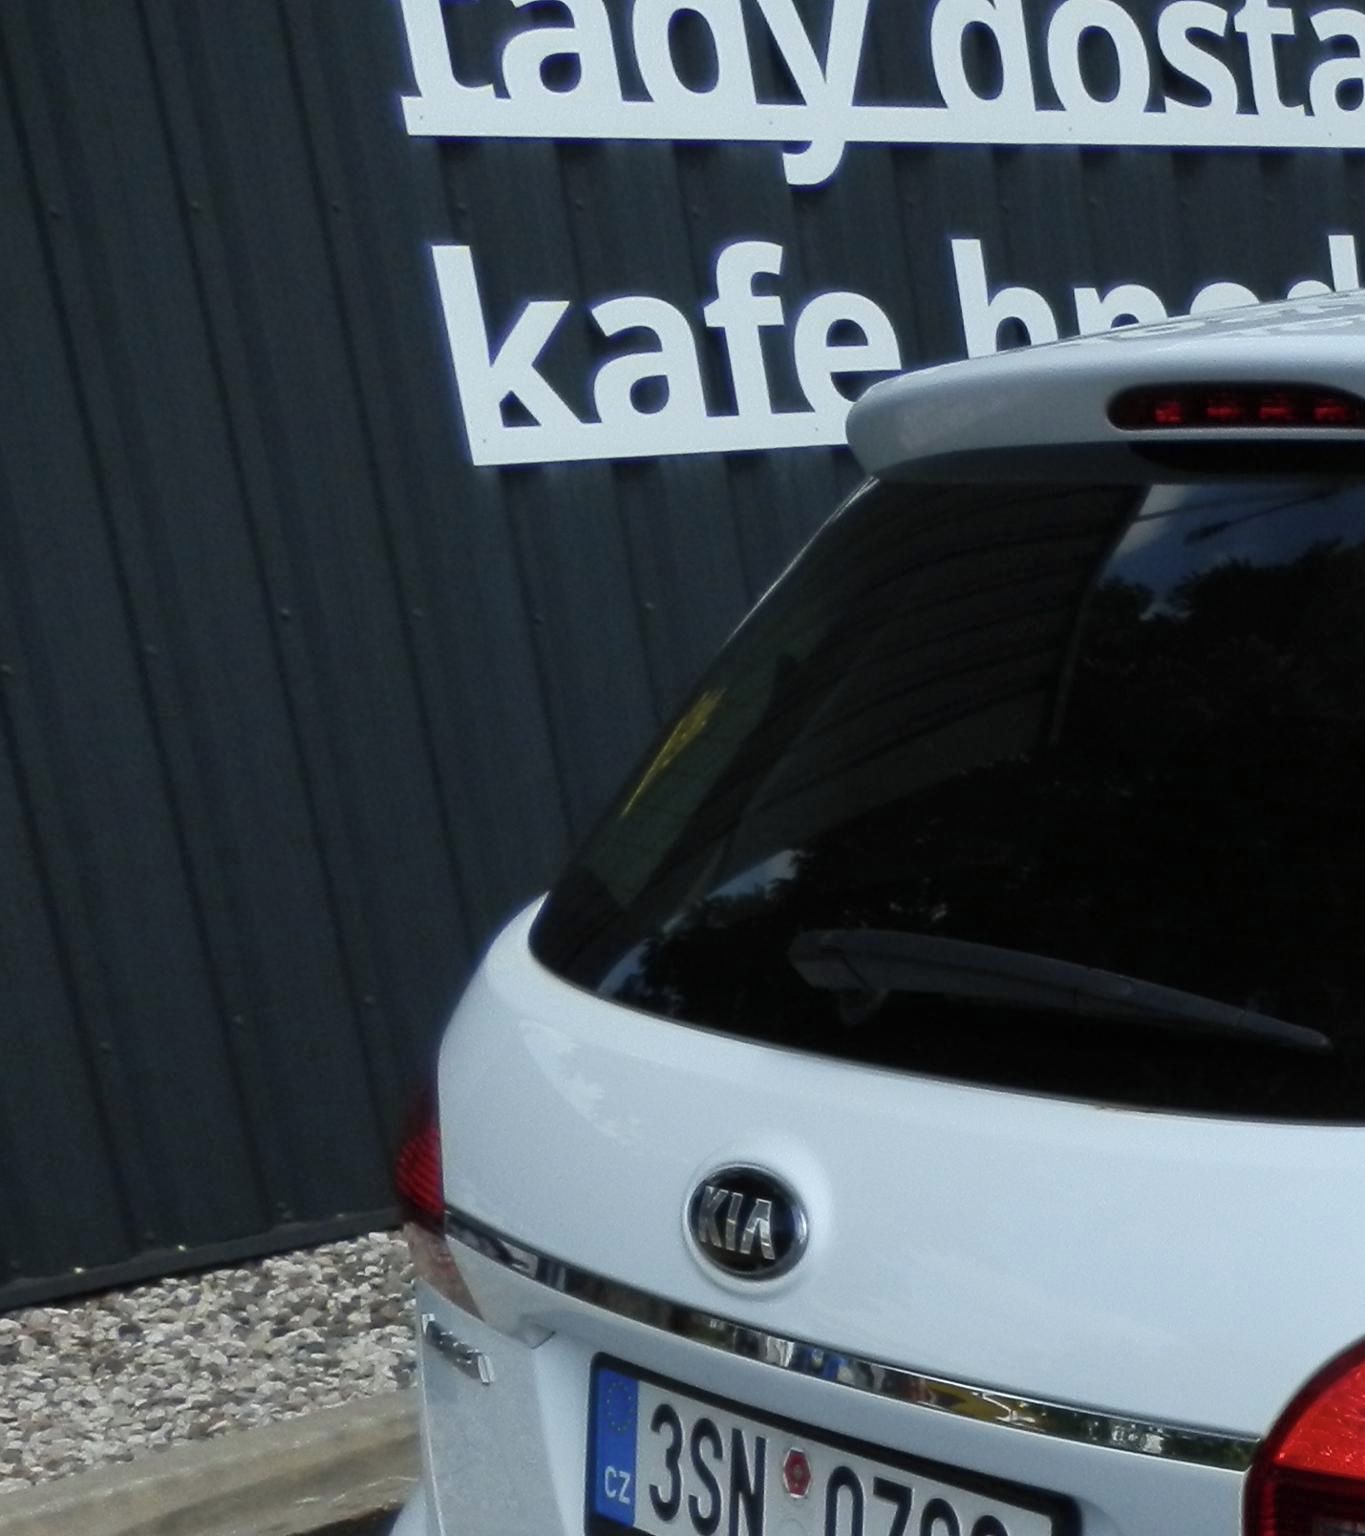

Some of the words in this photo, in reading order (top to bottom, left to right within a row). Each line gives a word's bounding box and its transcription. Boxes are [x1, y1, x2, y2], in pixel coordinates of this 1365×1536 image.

[431, 241, 900, 450] kafe
[698, 1185, 776, 1260] KIA
[603, 1466, 632, 1504] CZ
